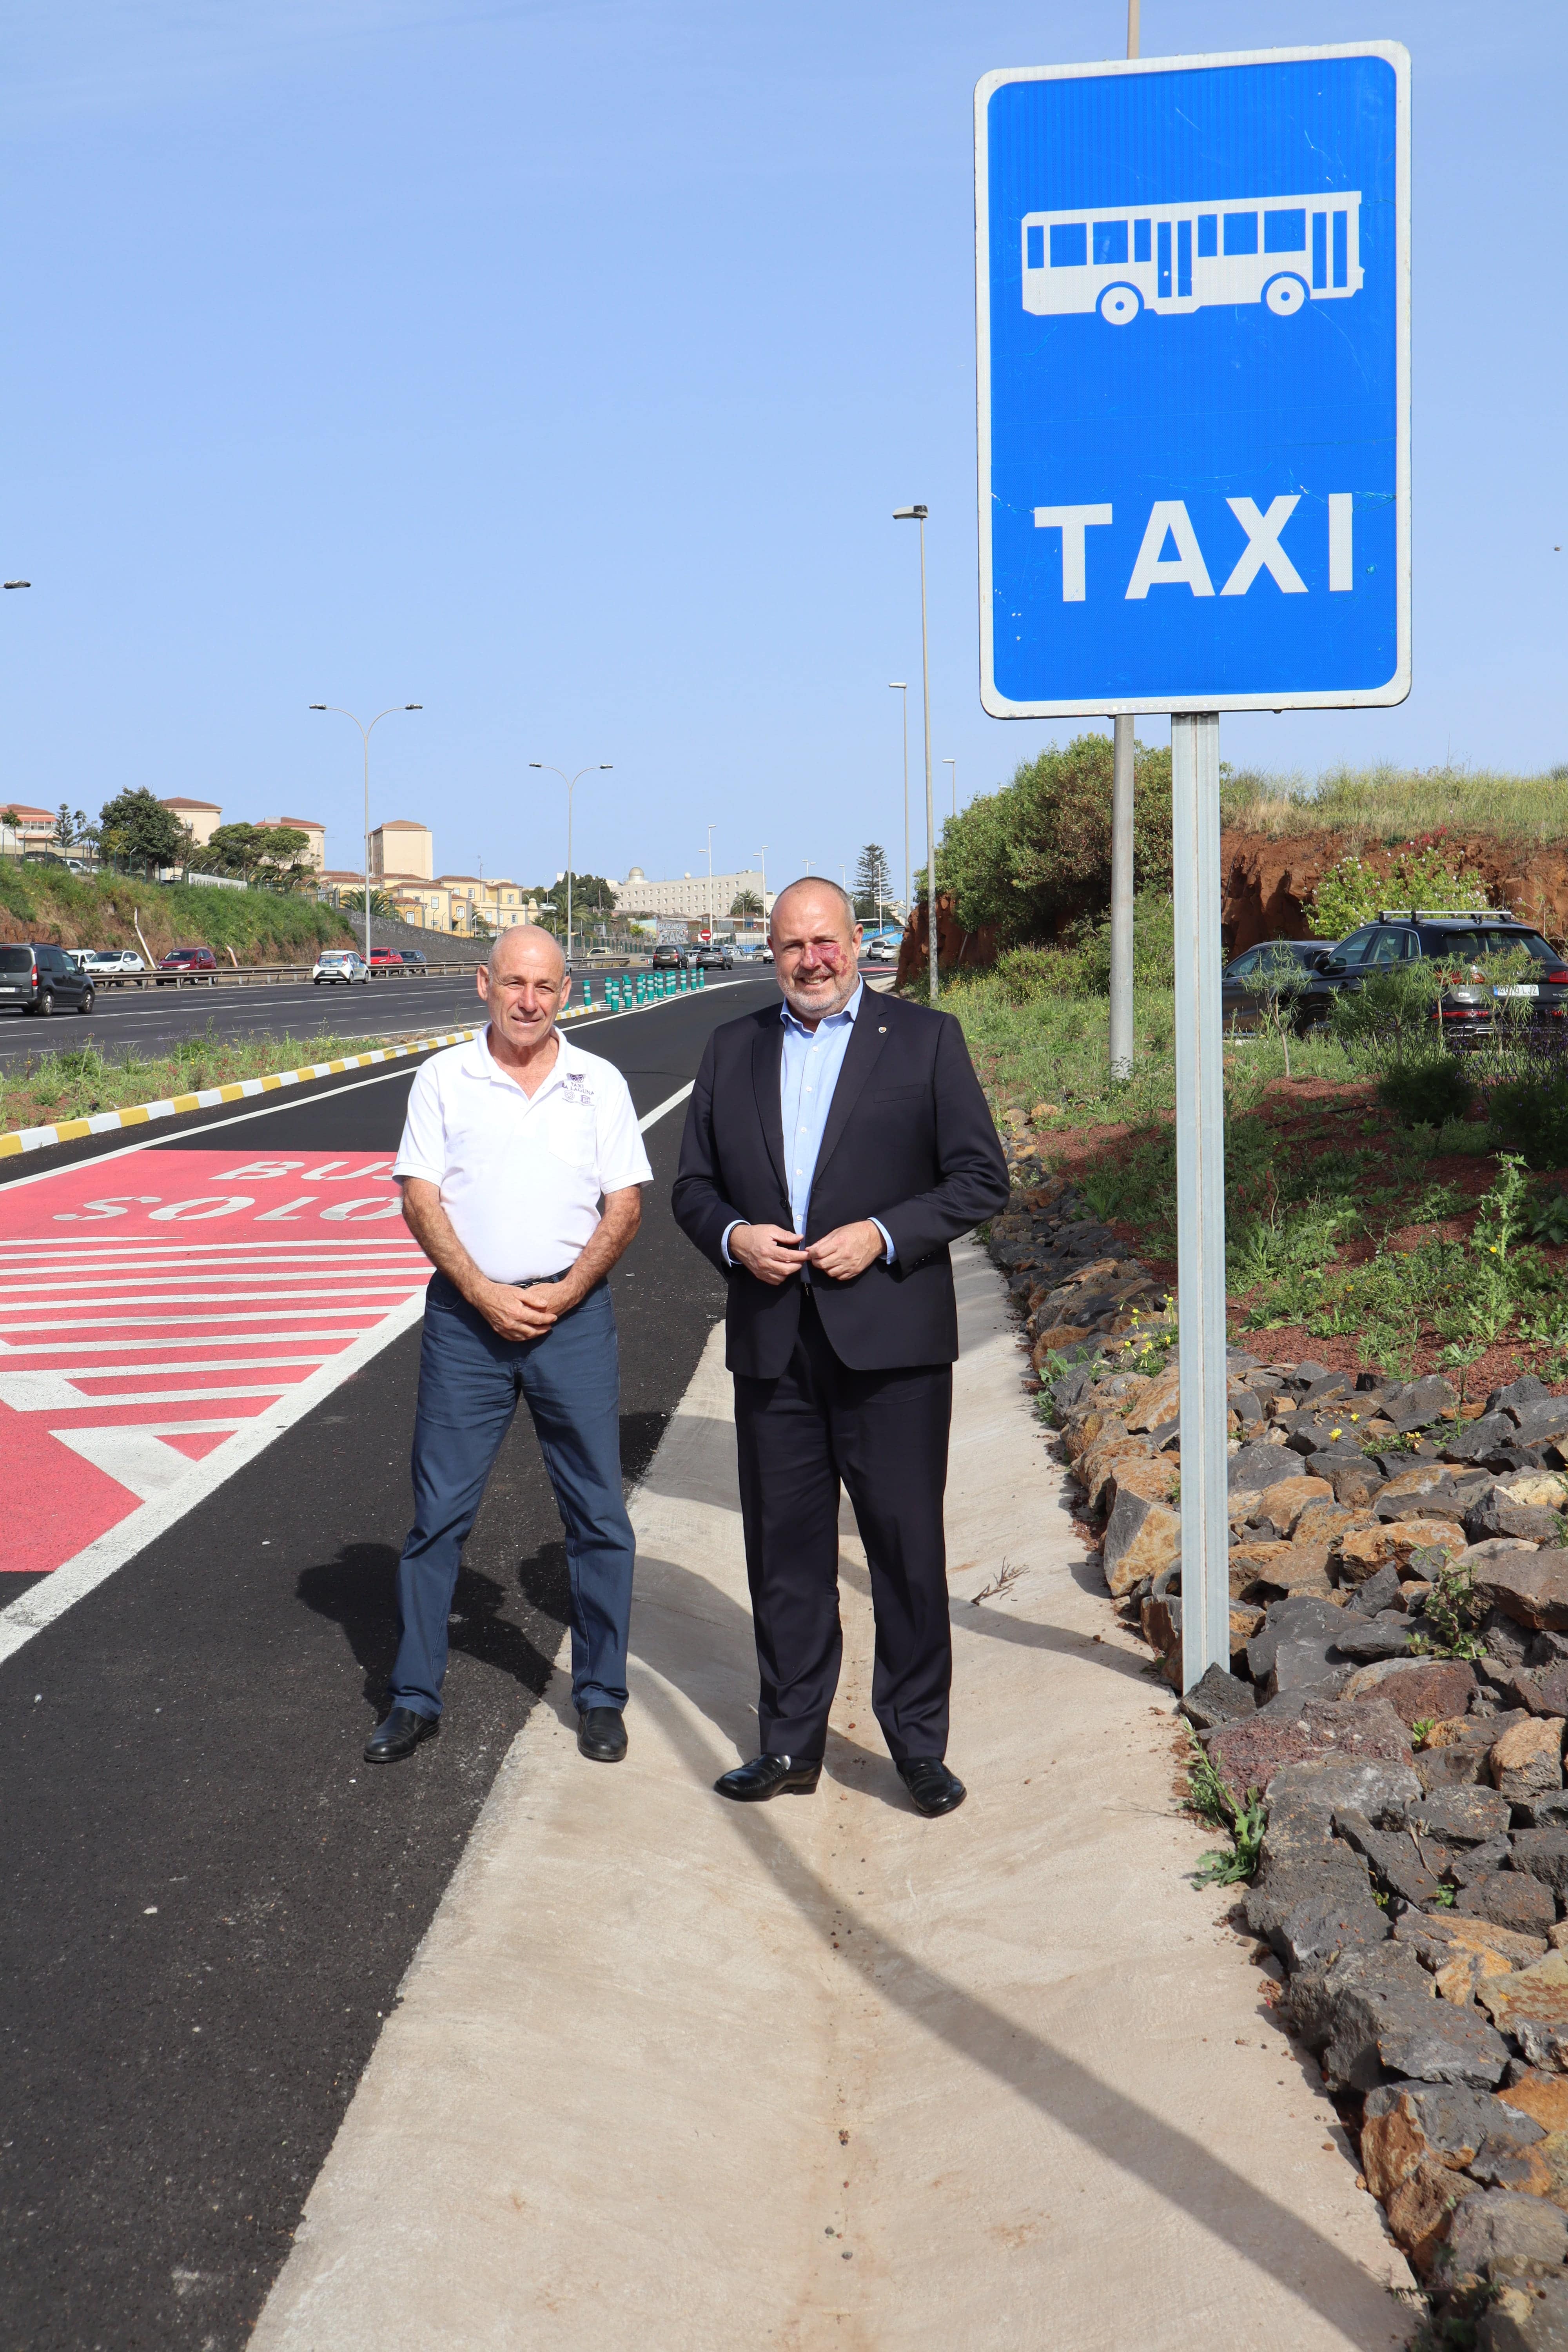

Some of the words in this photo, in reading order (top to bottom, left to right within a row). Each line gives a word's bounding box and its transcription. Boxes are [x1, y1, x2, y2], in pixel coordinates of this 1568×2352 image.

[1034, 492, 1353, 602] TAXI
[570, 1086, 594, 1095] LAGUNA
[52, 1196, 403, 1221] SOLO
